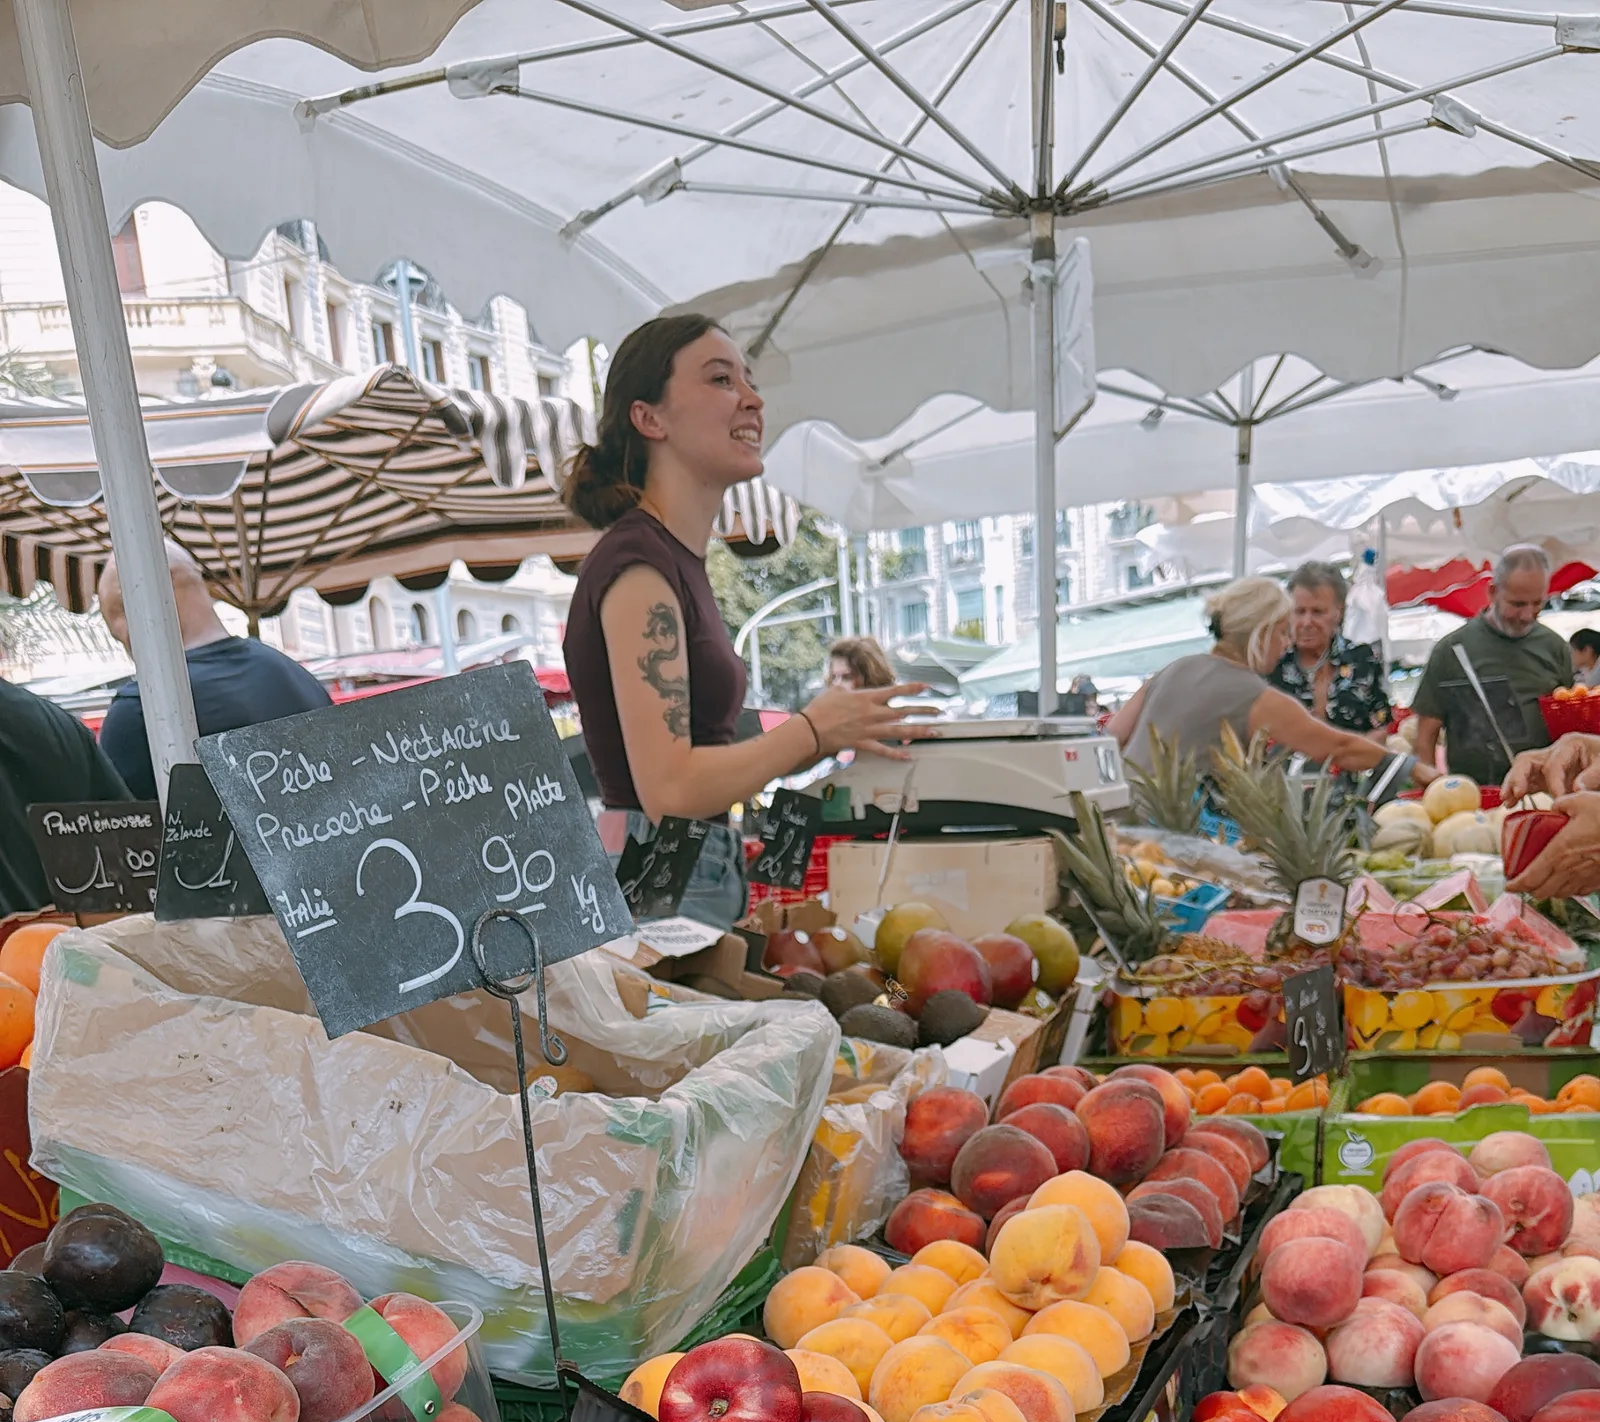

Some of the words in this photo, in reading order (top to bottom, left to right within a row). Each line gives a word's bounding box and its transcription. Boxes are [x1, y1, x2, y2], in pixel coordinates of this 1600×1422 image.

[246, 749, 332, 803] Pêche
[356, 838, 465, 994] 3
[482, 836, 556, 902] 90
